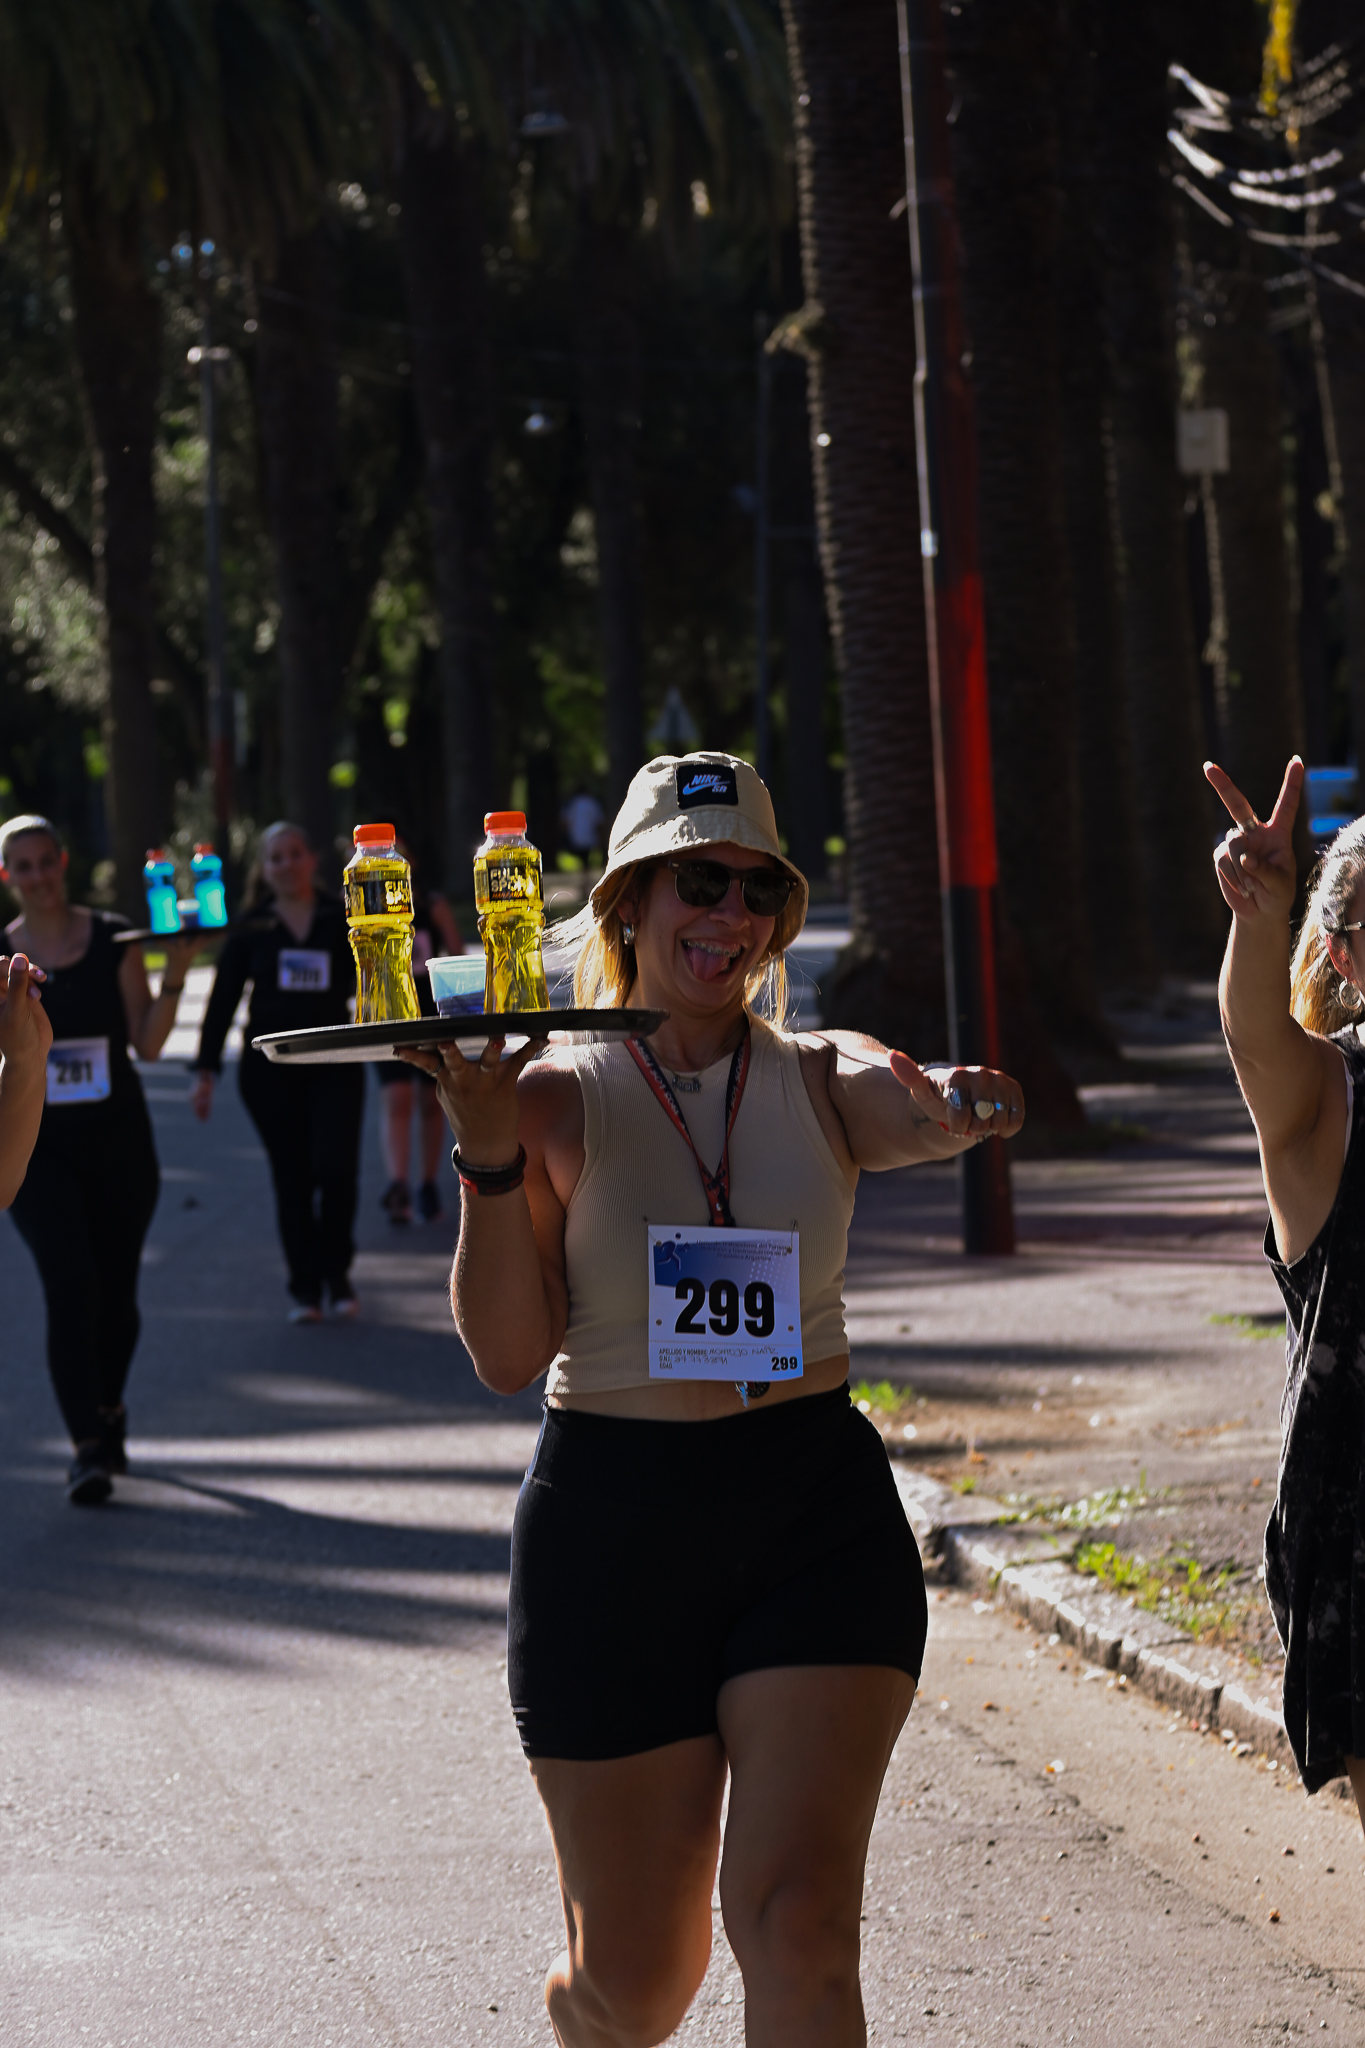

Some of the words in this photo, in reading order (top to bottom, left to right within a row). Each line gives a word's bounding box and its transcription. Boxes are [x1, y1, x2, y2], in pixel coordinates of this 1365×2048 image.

[691, 774, 721, 786] NIKE
[675, 1277, 774, 1337] 299
[771, 1356, 798, 1371] 299
